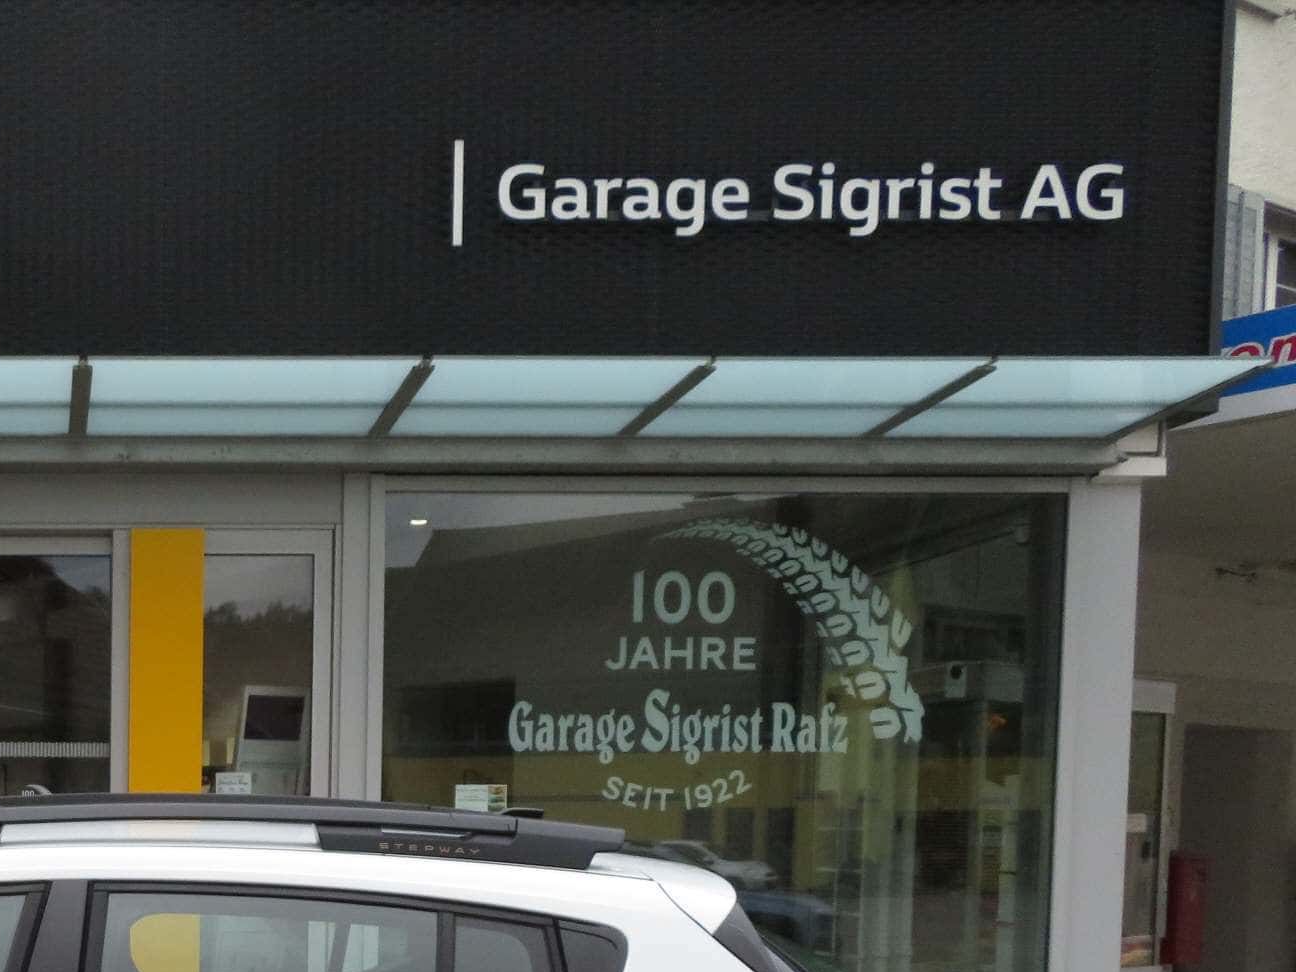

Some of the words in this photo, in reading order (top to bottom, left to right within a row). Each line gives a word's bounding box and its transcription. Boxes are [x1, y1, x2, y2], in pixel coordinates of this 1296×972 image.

[498, 164, 751, 236] Garage
[772, 162, 1002, 236] Sigrist
[1020, 164, 1125, 220] AG
[631, 569, 737, 625] 100
[605, 636, 757, 672] JAHRE
[508, 700, 636, 765] Garage
[641, 688, 763, 765] Sigrist
[770, 700, 849, 755] Rafz
[602, 776, 675, 812] SEIT
[684, 769, 752, 811] 1922
[378, 841, 481, 856] STEPWAY
